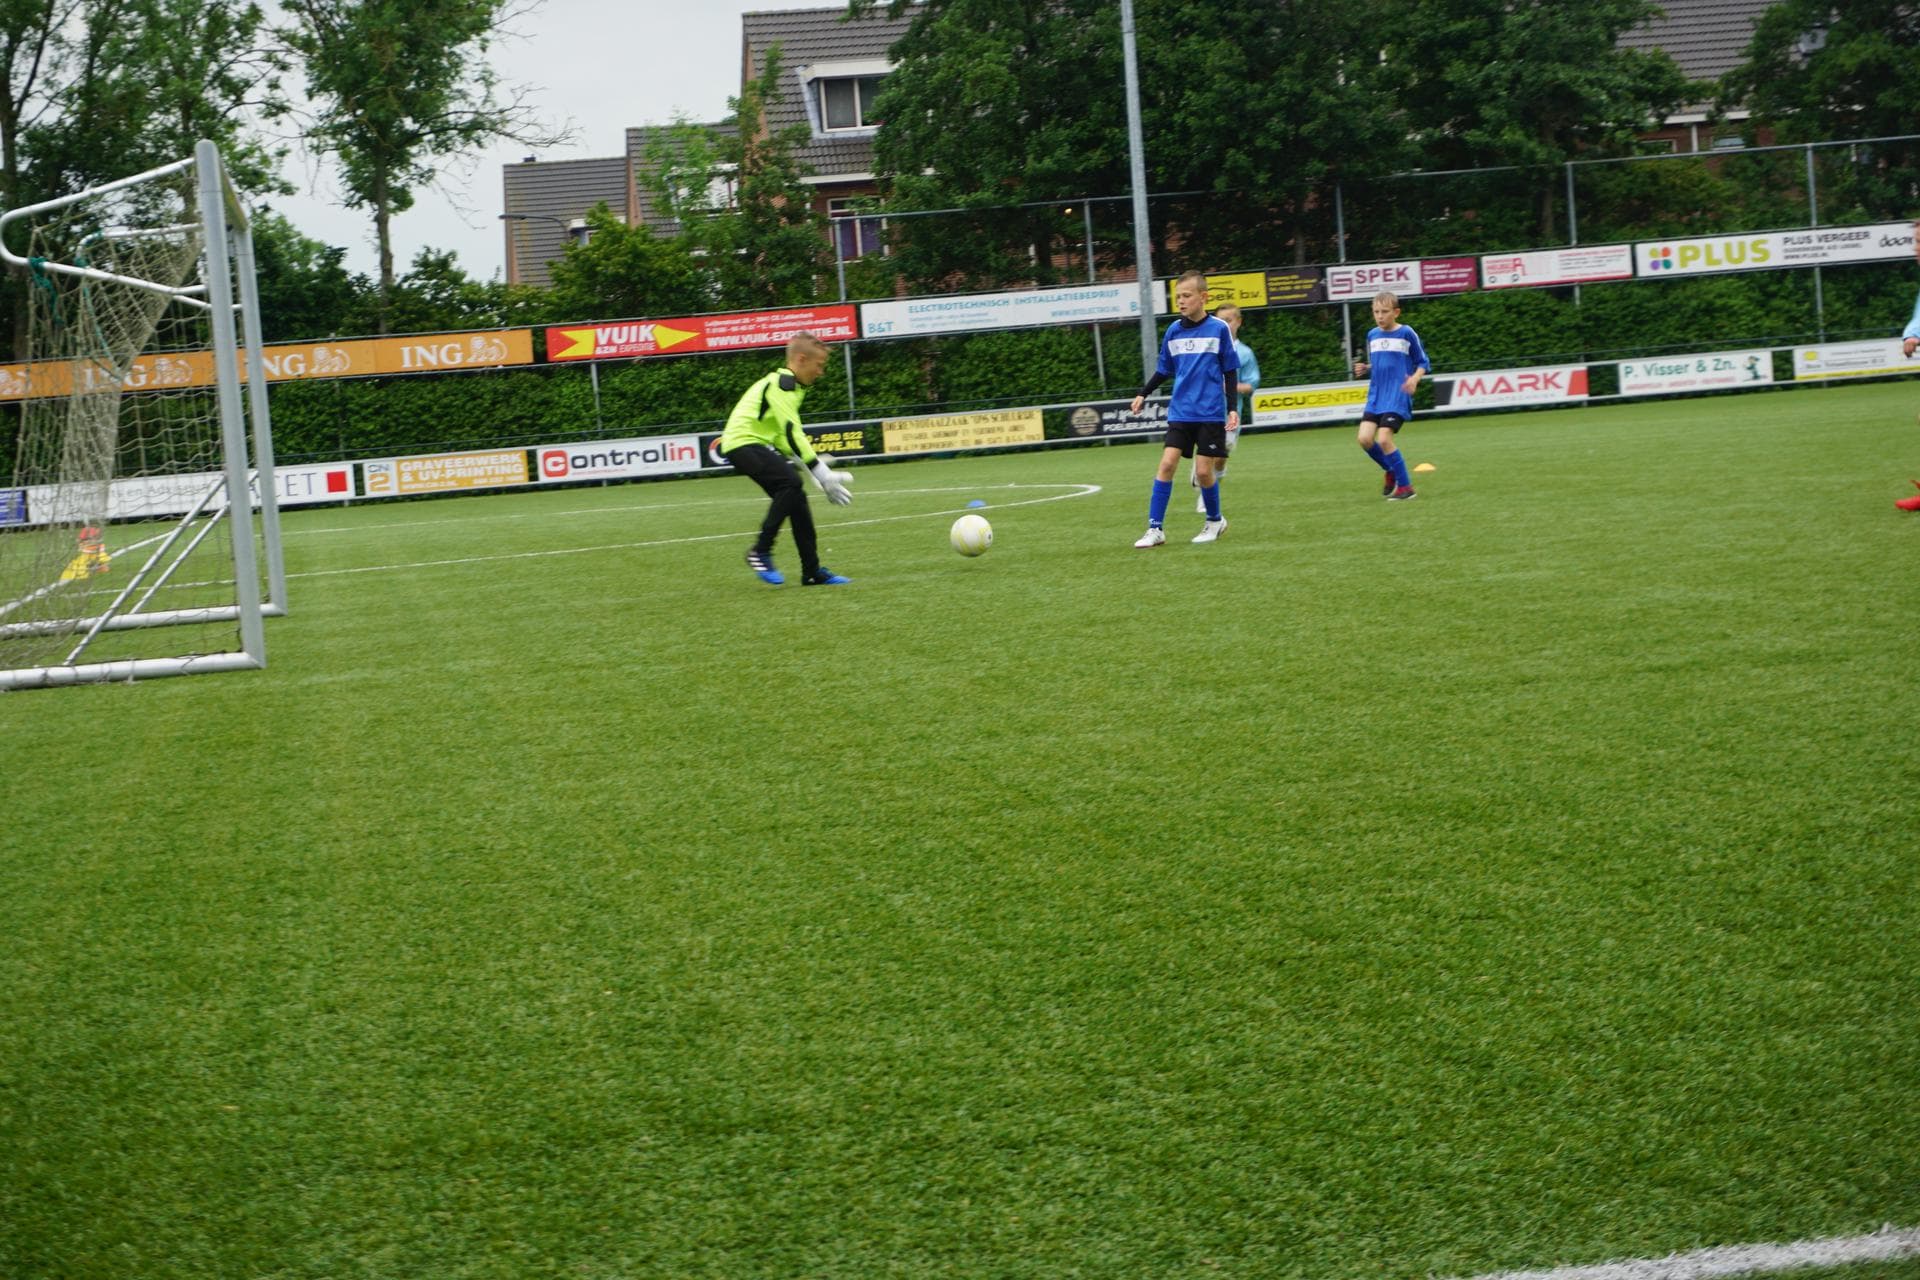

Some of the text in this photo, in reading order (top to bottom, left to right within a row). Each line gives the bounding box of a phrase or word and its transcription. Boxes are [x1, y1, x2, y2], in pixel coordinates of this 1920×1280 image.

[1783, 230, 1871, 246] PLUS VERGEER
[1678, 239, 1771, 269] PLUS
[1355, 266, 1410, 285] SPEK
[908, 299, 1010, 314] ELECTROTECHNISCH
[595, 323, 657, 345] VUIK
[867, 321, 894, 334] B&T
[400, 343, 464, 368] ING
[1643, 361, 1690, 378] Visser
[1695, 358, 1708, 372] &
[1713, 356, 1737, 371] Zn.
[1457, 371, 1563, 398] MARK
[401, 453, 521, 472] GRAVEERWERK
[402, 471, 415, 483] &
[418, 463, 524, 481] UV-PRINTING
